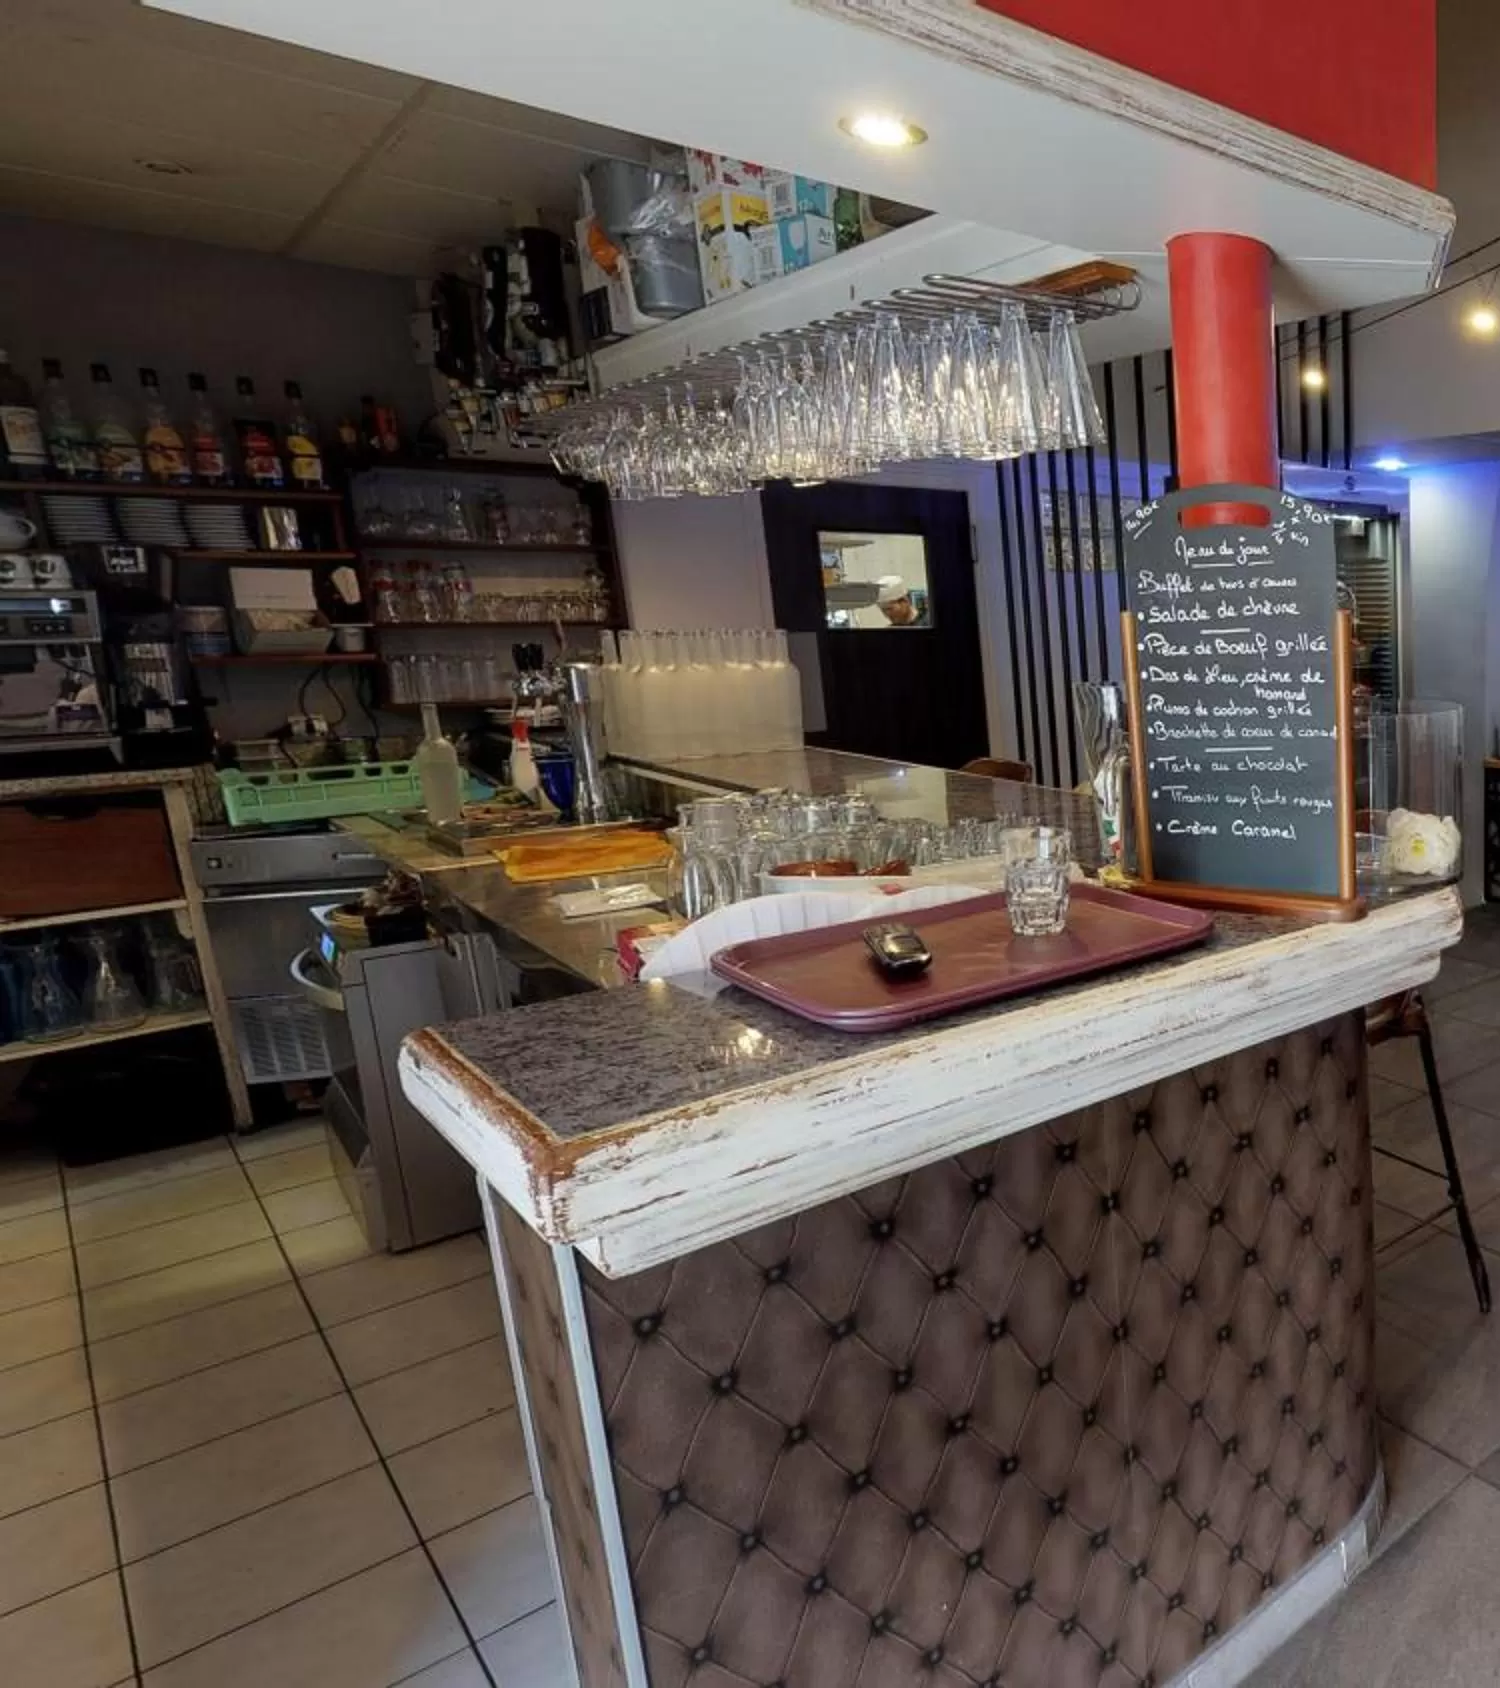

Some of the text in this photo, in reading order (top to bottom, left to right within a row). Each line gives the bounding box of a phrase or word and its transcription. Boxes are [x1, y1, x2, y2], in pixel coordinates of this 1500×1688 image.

[1237, 536, 1270, 565] jour
[1139, 570, 1194, 598] Buffet
[1200, 580, 1216, 592] de
[1148, 596, 1300, 623] Salade de chèvre
[1194, 641, 1213, 655] de
[1149, 666, 1179, 683] Dos
[1183, 667, 1200, 683] de
[1300, 667, 1326, 684] de
[1253, 685, 1307, 701] homard
[1195, 698, 1209, 716] de
[1213, 698, 1258, 717] cochon
[1153, 720, 1218, 741] Brochette
[1224, 722, 1237, 738] de
[1279, 723, 1294, 739] de
[1156, 755, 1309, 774] Tarte au chocolat
[1161, 785, 1219, 803] Tiramisu
[1250, 784, 1287, 812] fruits
[1167, 819, 1297, 841] Crème Caramel
